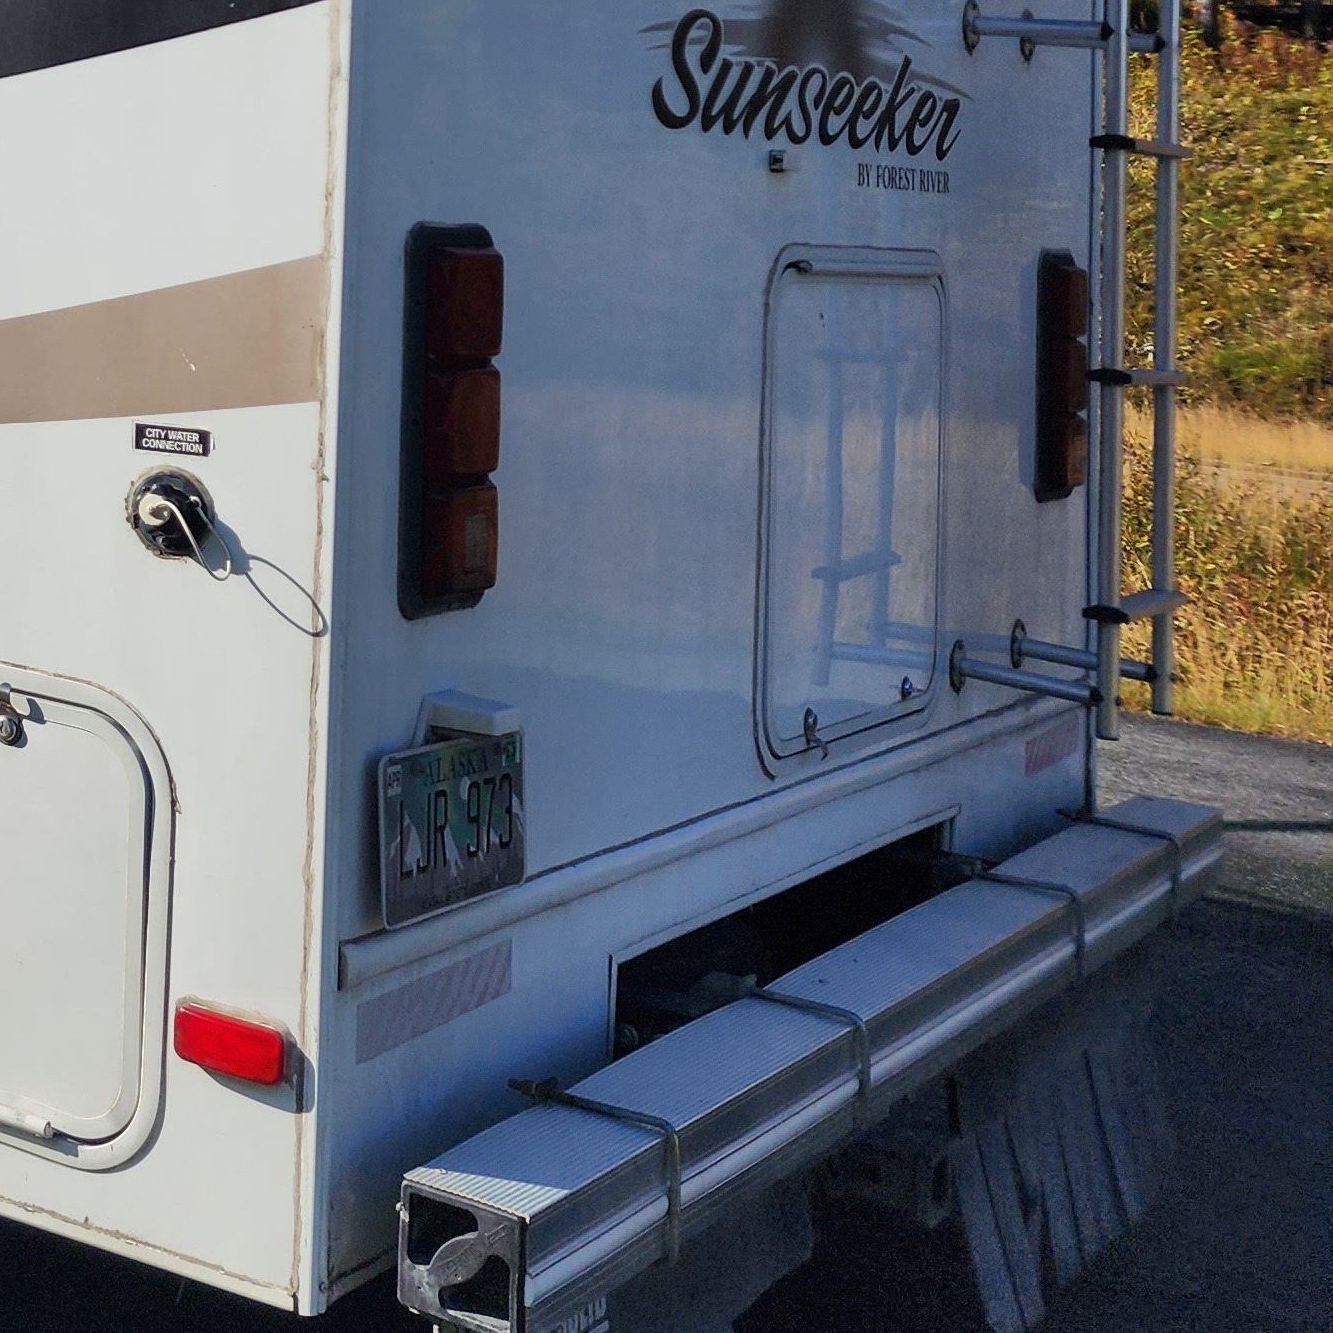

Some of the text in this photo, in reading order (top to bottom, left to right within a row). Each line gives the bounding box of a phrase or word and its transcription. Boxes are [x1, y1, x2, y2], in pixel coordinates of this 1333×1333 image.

[652, 9, 962, 162] Sunseeker
[858, 163, 950, 194] BY FOREST RIVER
[142, 438, 203, 454] CONNECTION
[145, 428, 200, 442] CITY WATER
[425, 746, 489, 787] ALASKA
[399, 772, 514, 880] LJR 973
